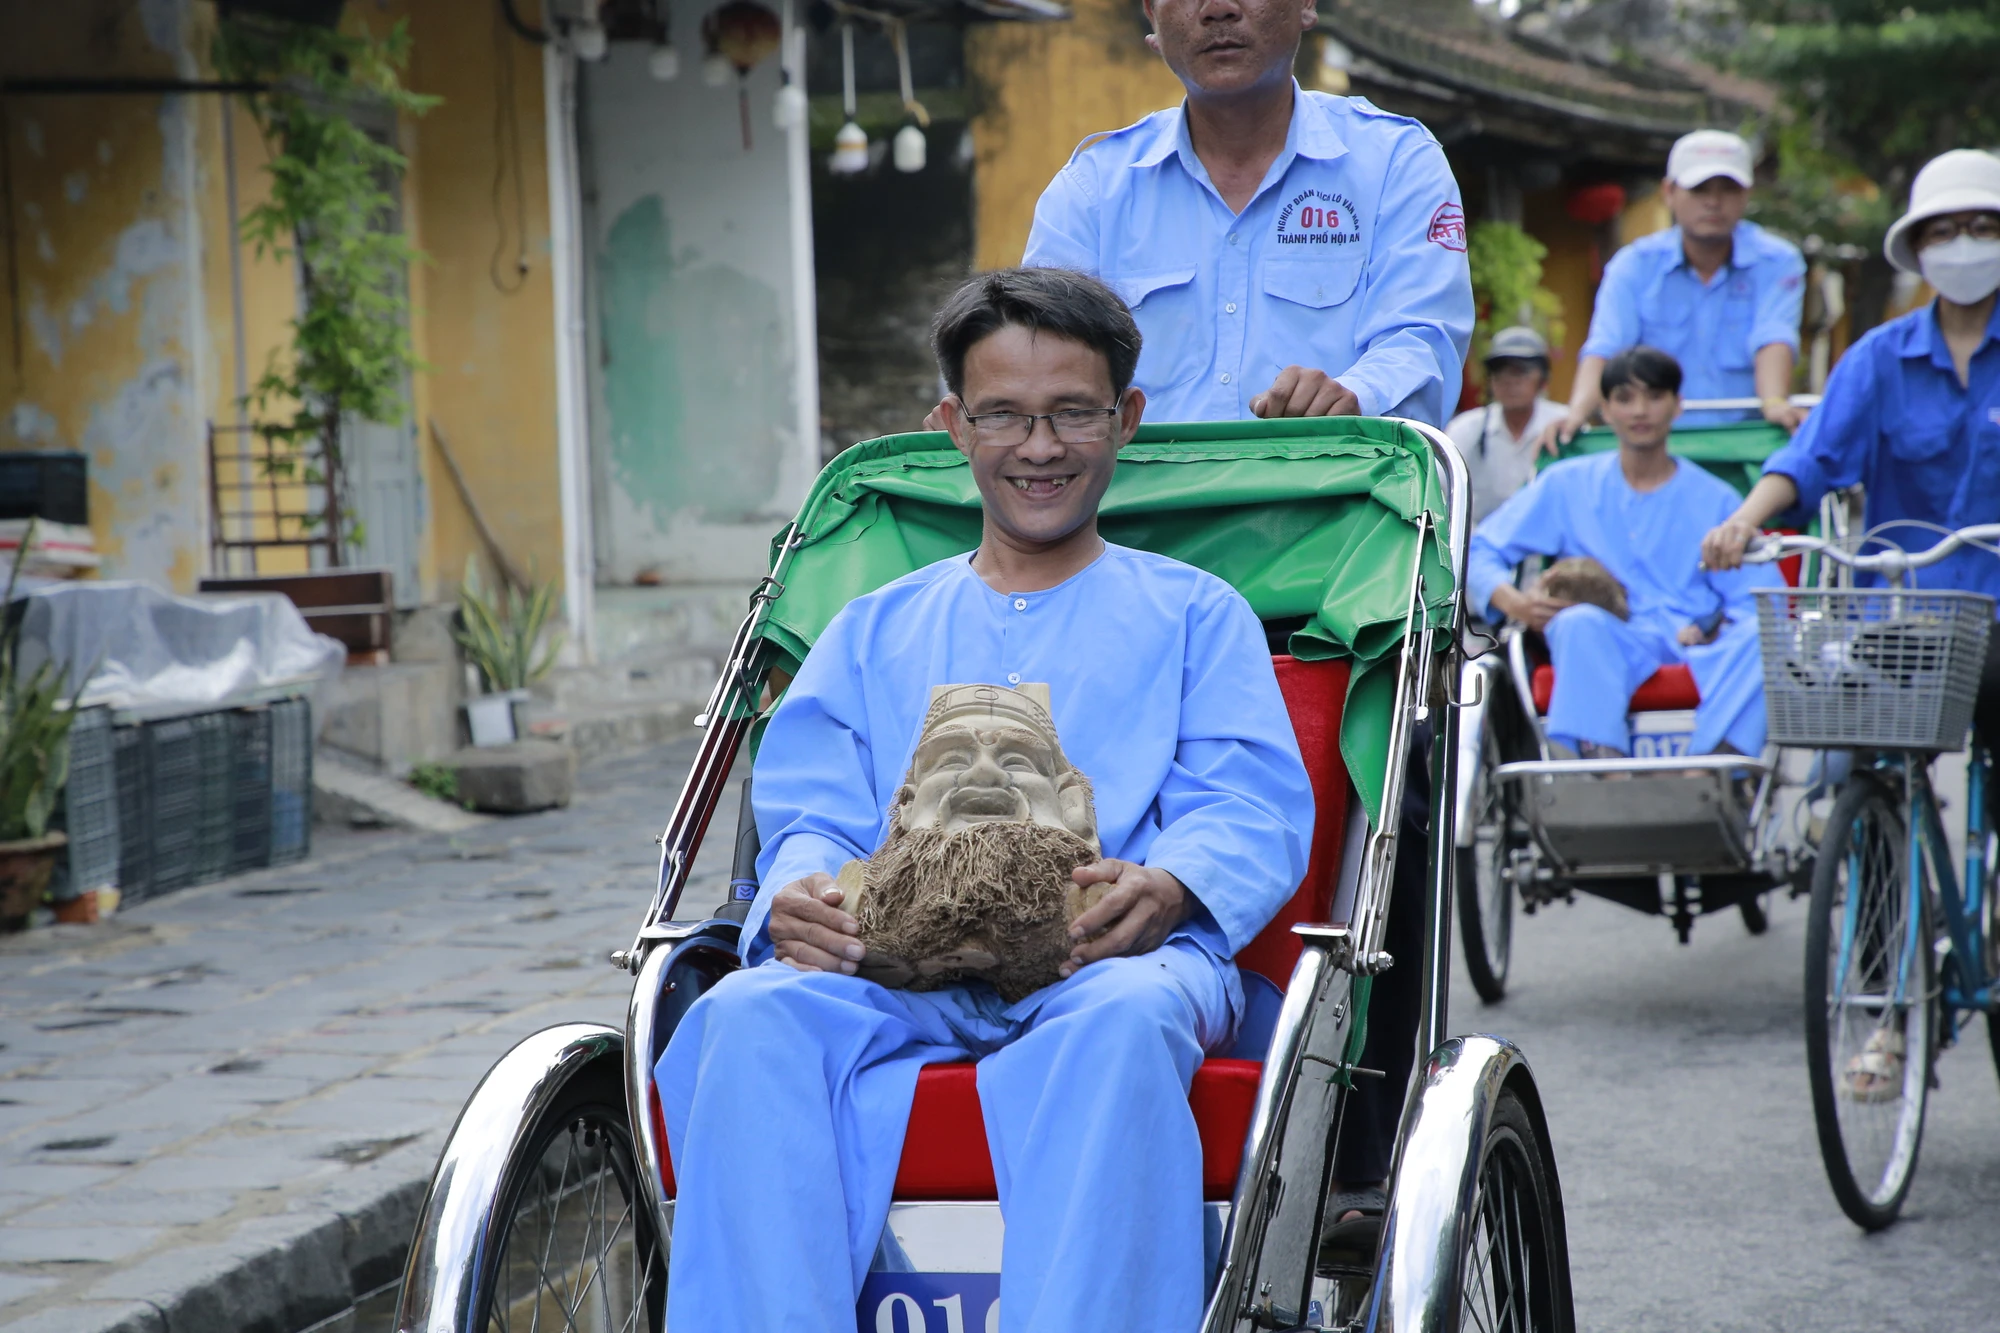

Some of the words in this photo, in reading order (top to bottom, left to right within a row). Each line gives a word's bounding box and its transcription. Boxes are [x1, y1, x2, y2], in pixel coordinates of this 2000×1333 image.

[1277, 203, 1294, 232] NGHIỆP
[1293, 189, 1315, 205] ĐOÀN
[1301, 206, 1340, 228] 016
[1277, 232, 1307, 244] THÀNH
[1310, 230, 1329, 244] PHỐ
[1331, 231, 1347, 246] HỘI
[1349, 232, 1360, 243] AN
[875, 1292, 1000, 1333] 01
